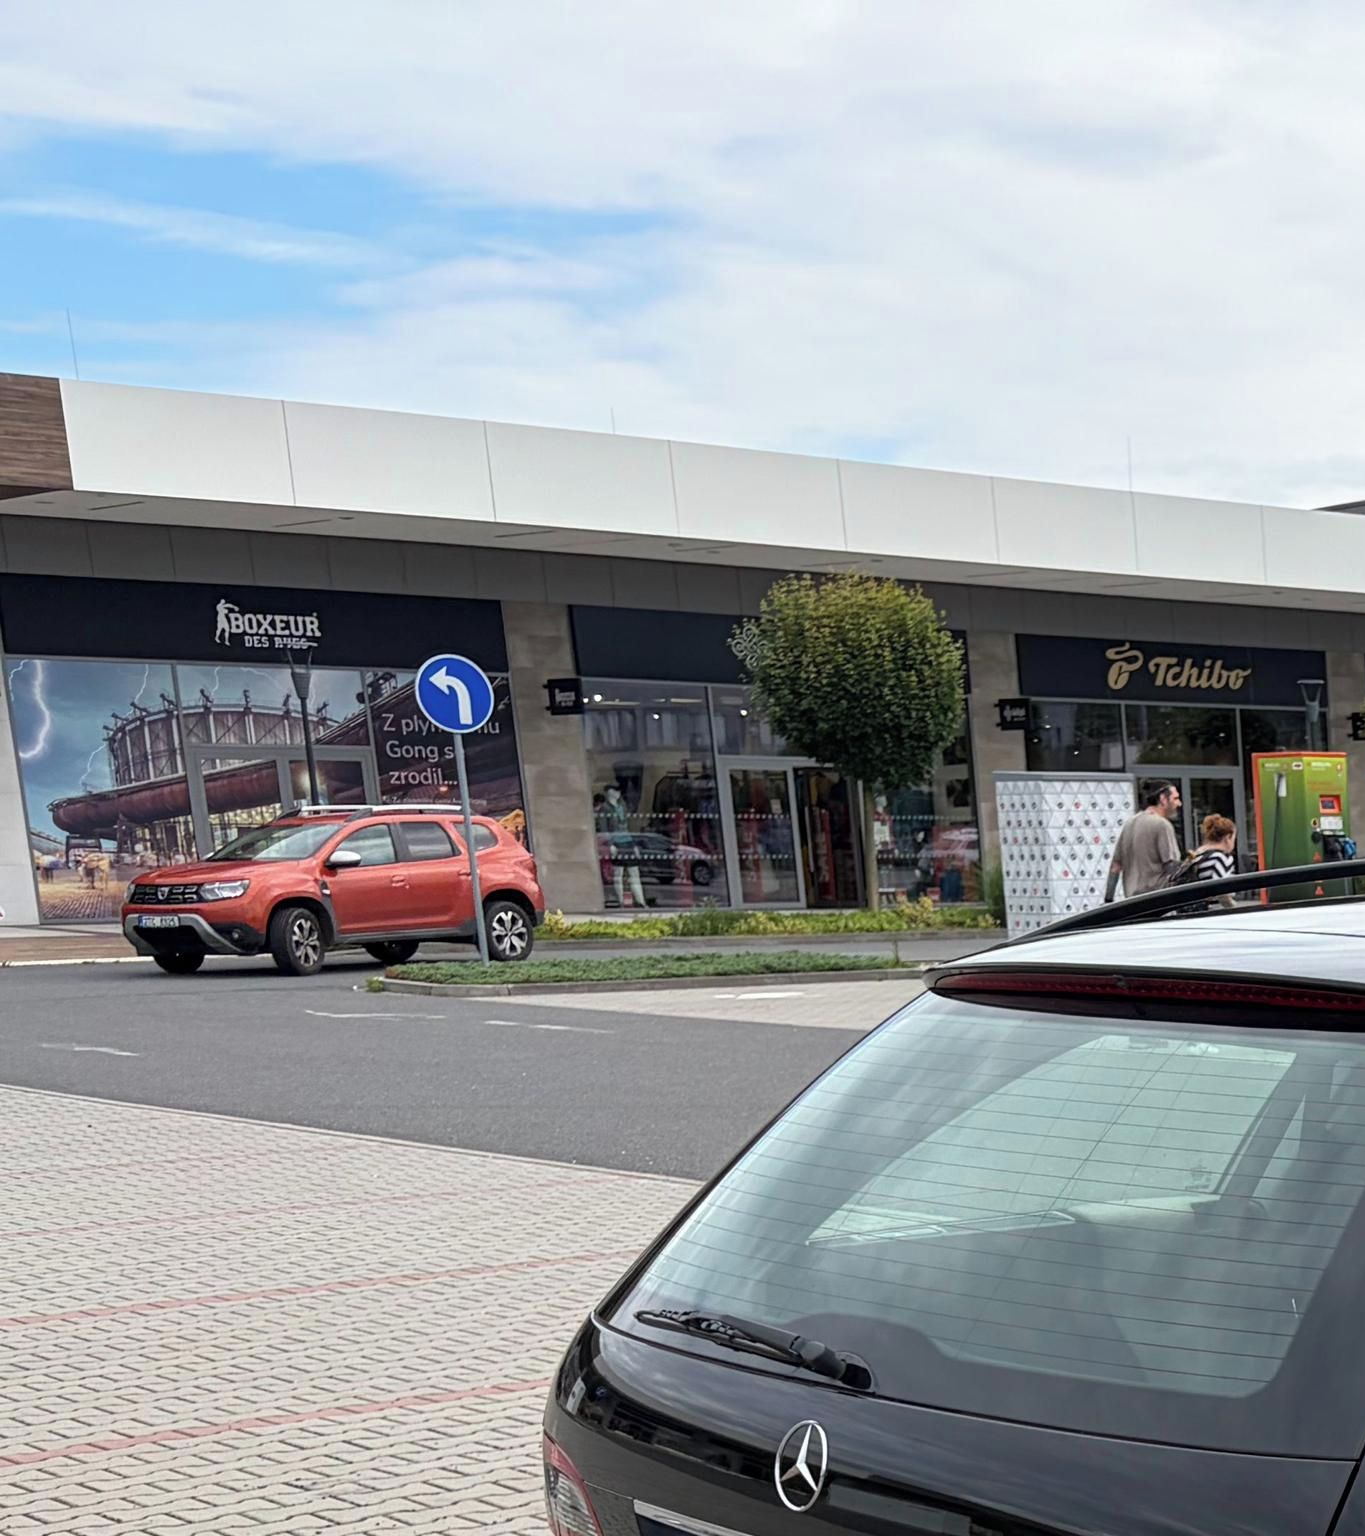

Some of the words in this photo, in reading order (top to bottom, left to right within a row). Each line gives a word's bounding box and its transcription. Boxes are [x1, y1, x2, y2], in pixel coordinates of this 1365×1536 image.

[228, 613, 322, 637] BOXEUR
[244, 636, 270, 648] DES
[1148, 656, 1252, 690] Tchibo
[382, 713, 396, 732] Z
[386, 740, 439, 763] Gong
[389, 767, 458, 785] zrodil...
